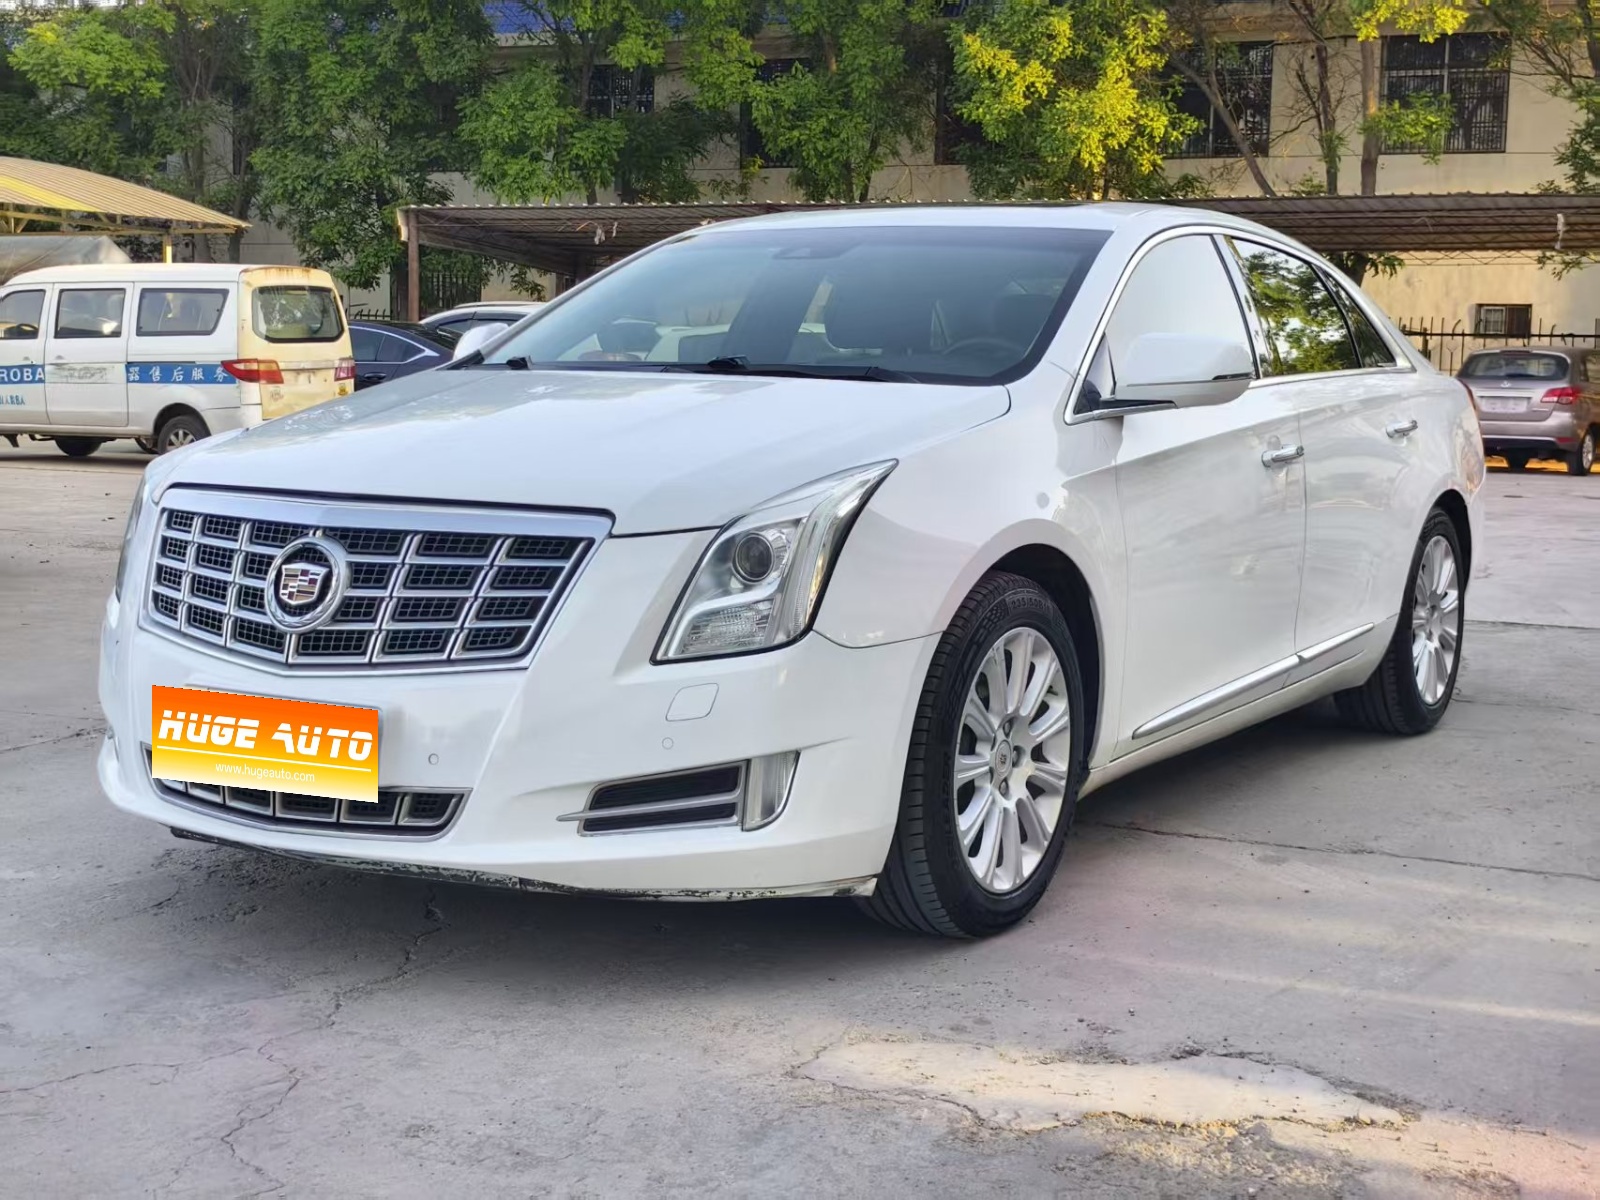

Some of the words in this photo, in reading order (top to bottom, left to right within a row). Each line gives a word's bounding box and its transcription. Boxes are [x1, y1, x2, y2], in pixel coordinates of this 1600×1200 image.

[128, 366, 229, 383] 器售后服务
